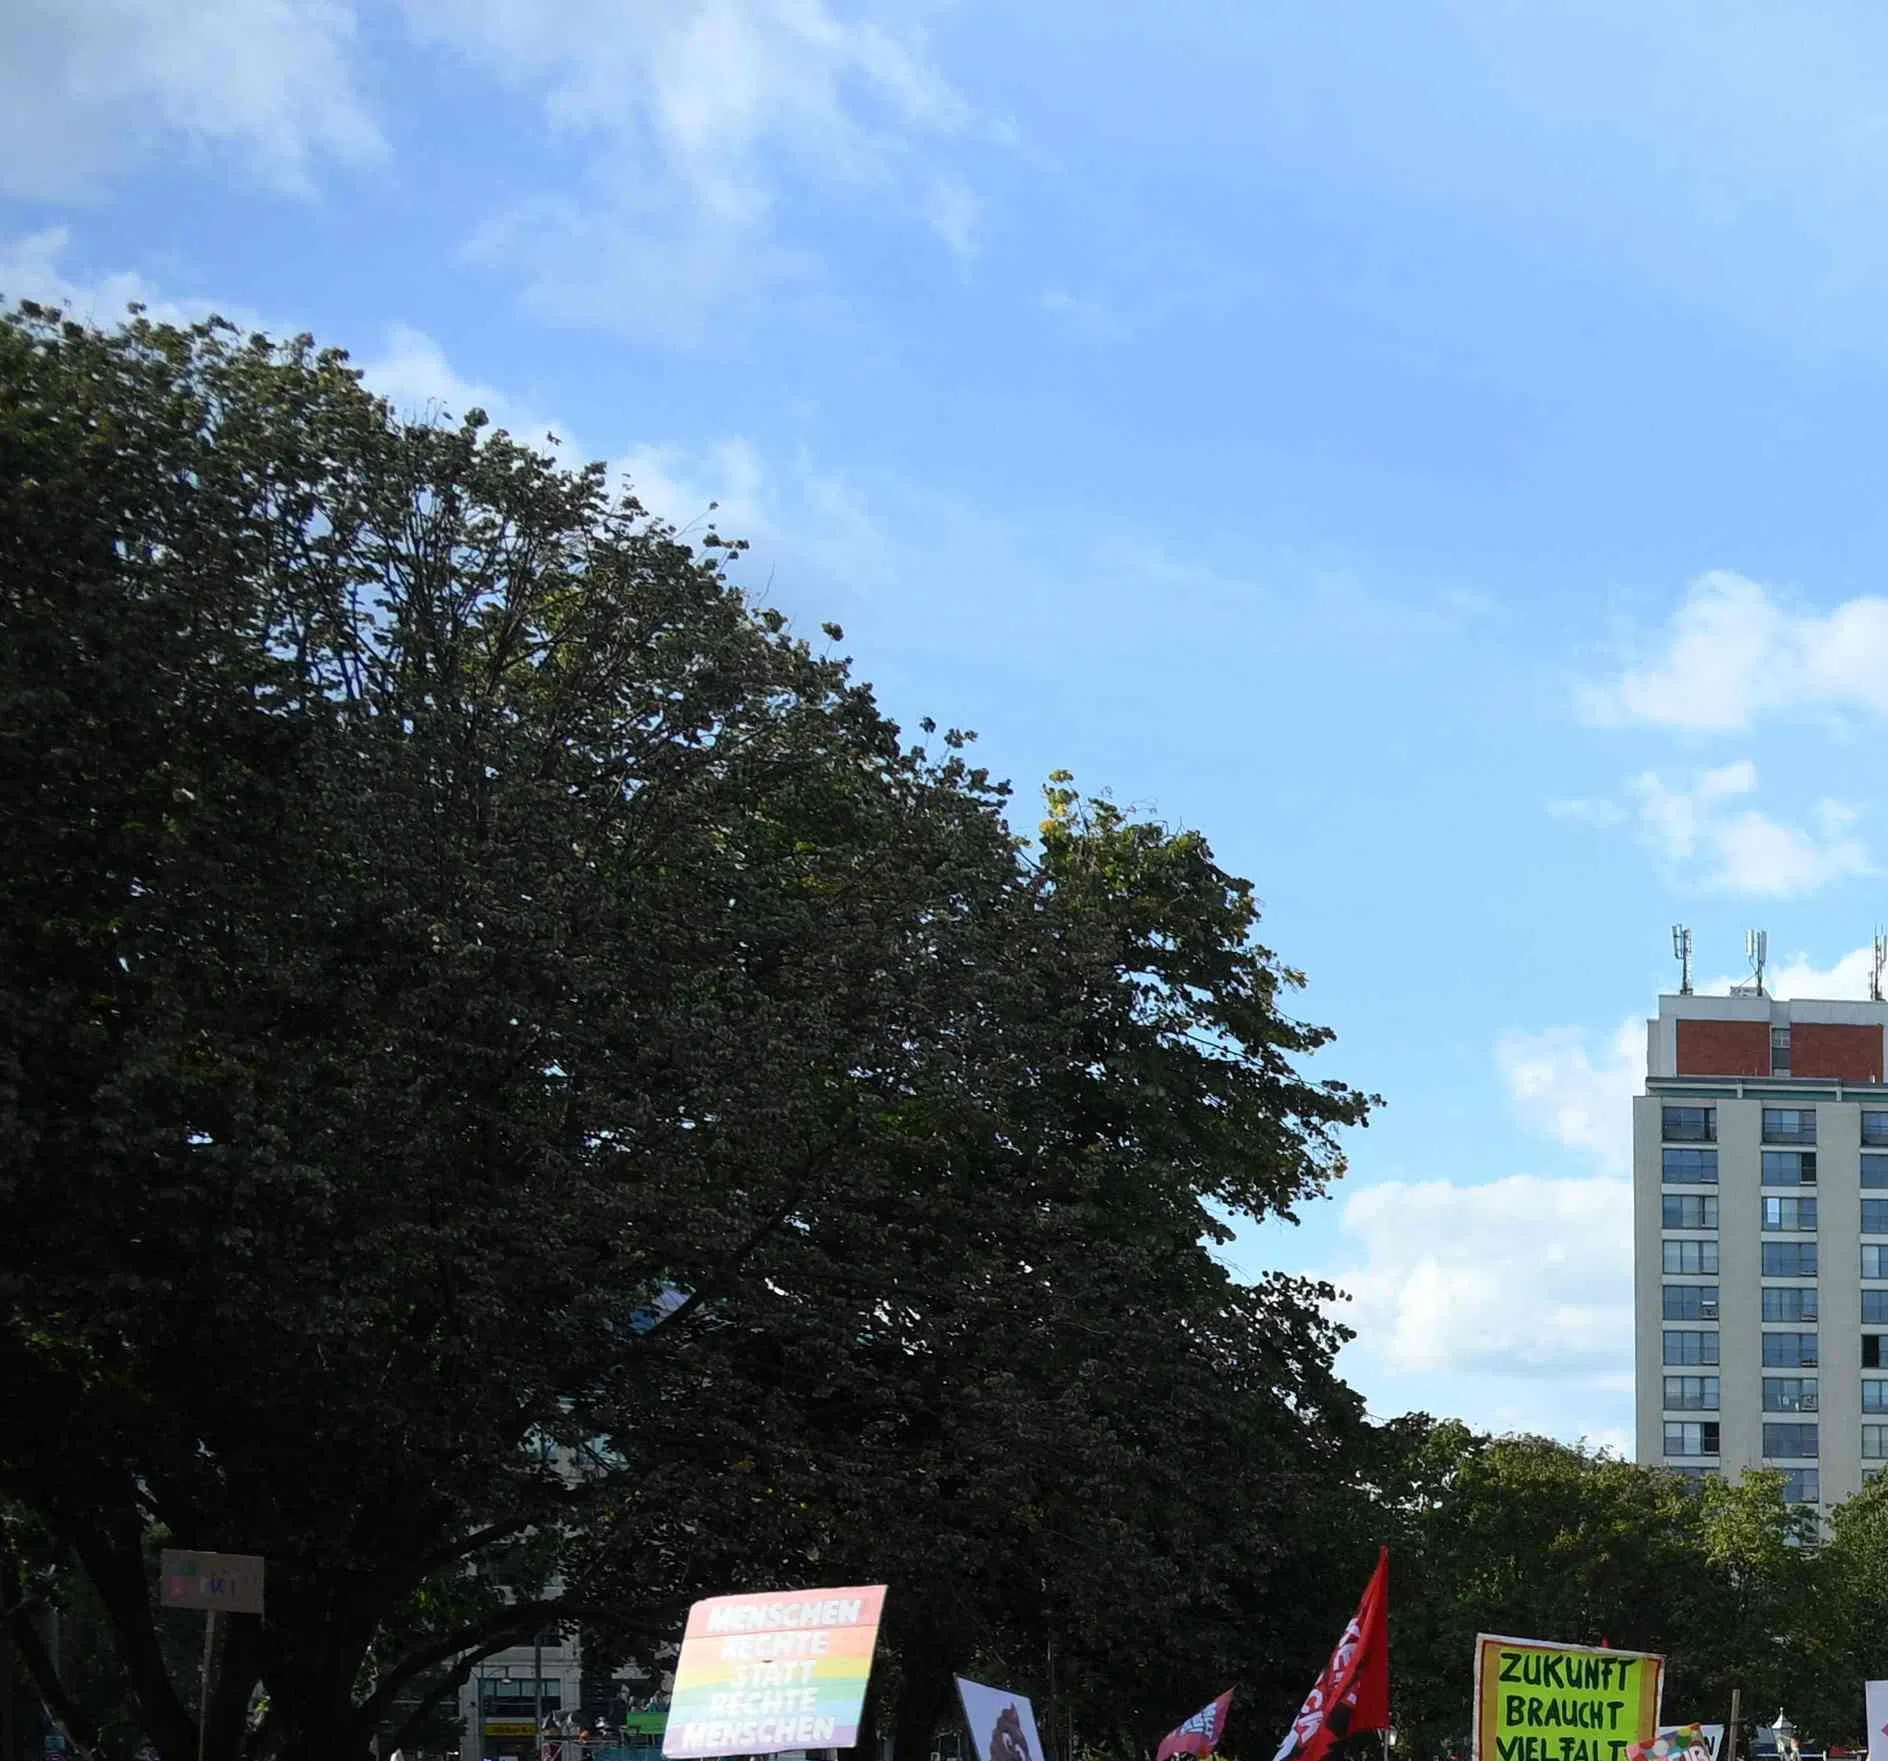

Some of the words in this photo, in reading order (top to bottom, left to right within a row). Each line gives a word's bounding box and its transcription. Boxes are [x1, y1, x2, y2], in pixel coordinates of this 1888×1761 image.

[708, 1599, 862, 1633] MENSCHEN
[720, 1631, 831, 1661] RECHTE
[734, 1661, 818, 1686] STATT
[1498, 1652, 1638, 1692] ZUKUNFT
[711, 1687, 820, 1714] RECHTE
[1505, 1695, 1625, 1731] BRAUCHT
[681, 1716, 836, 1749] MENSCHEN
